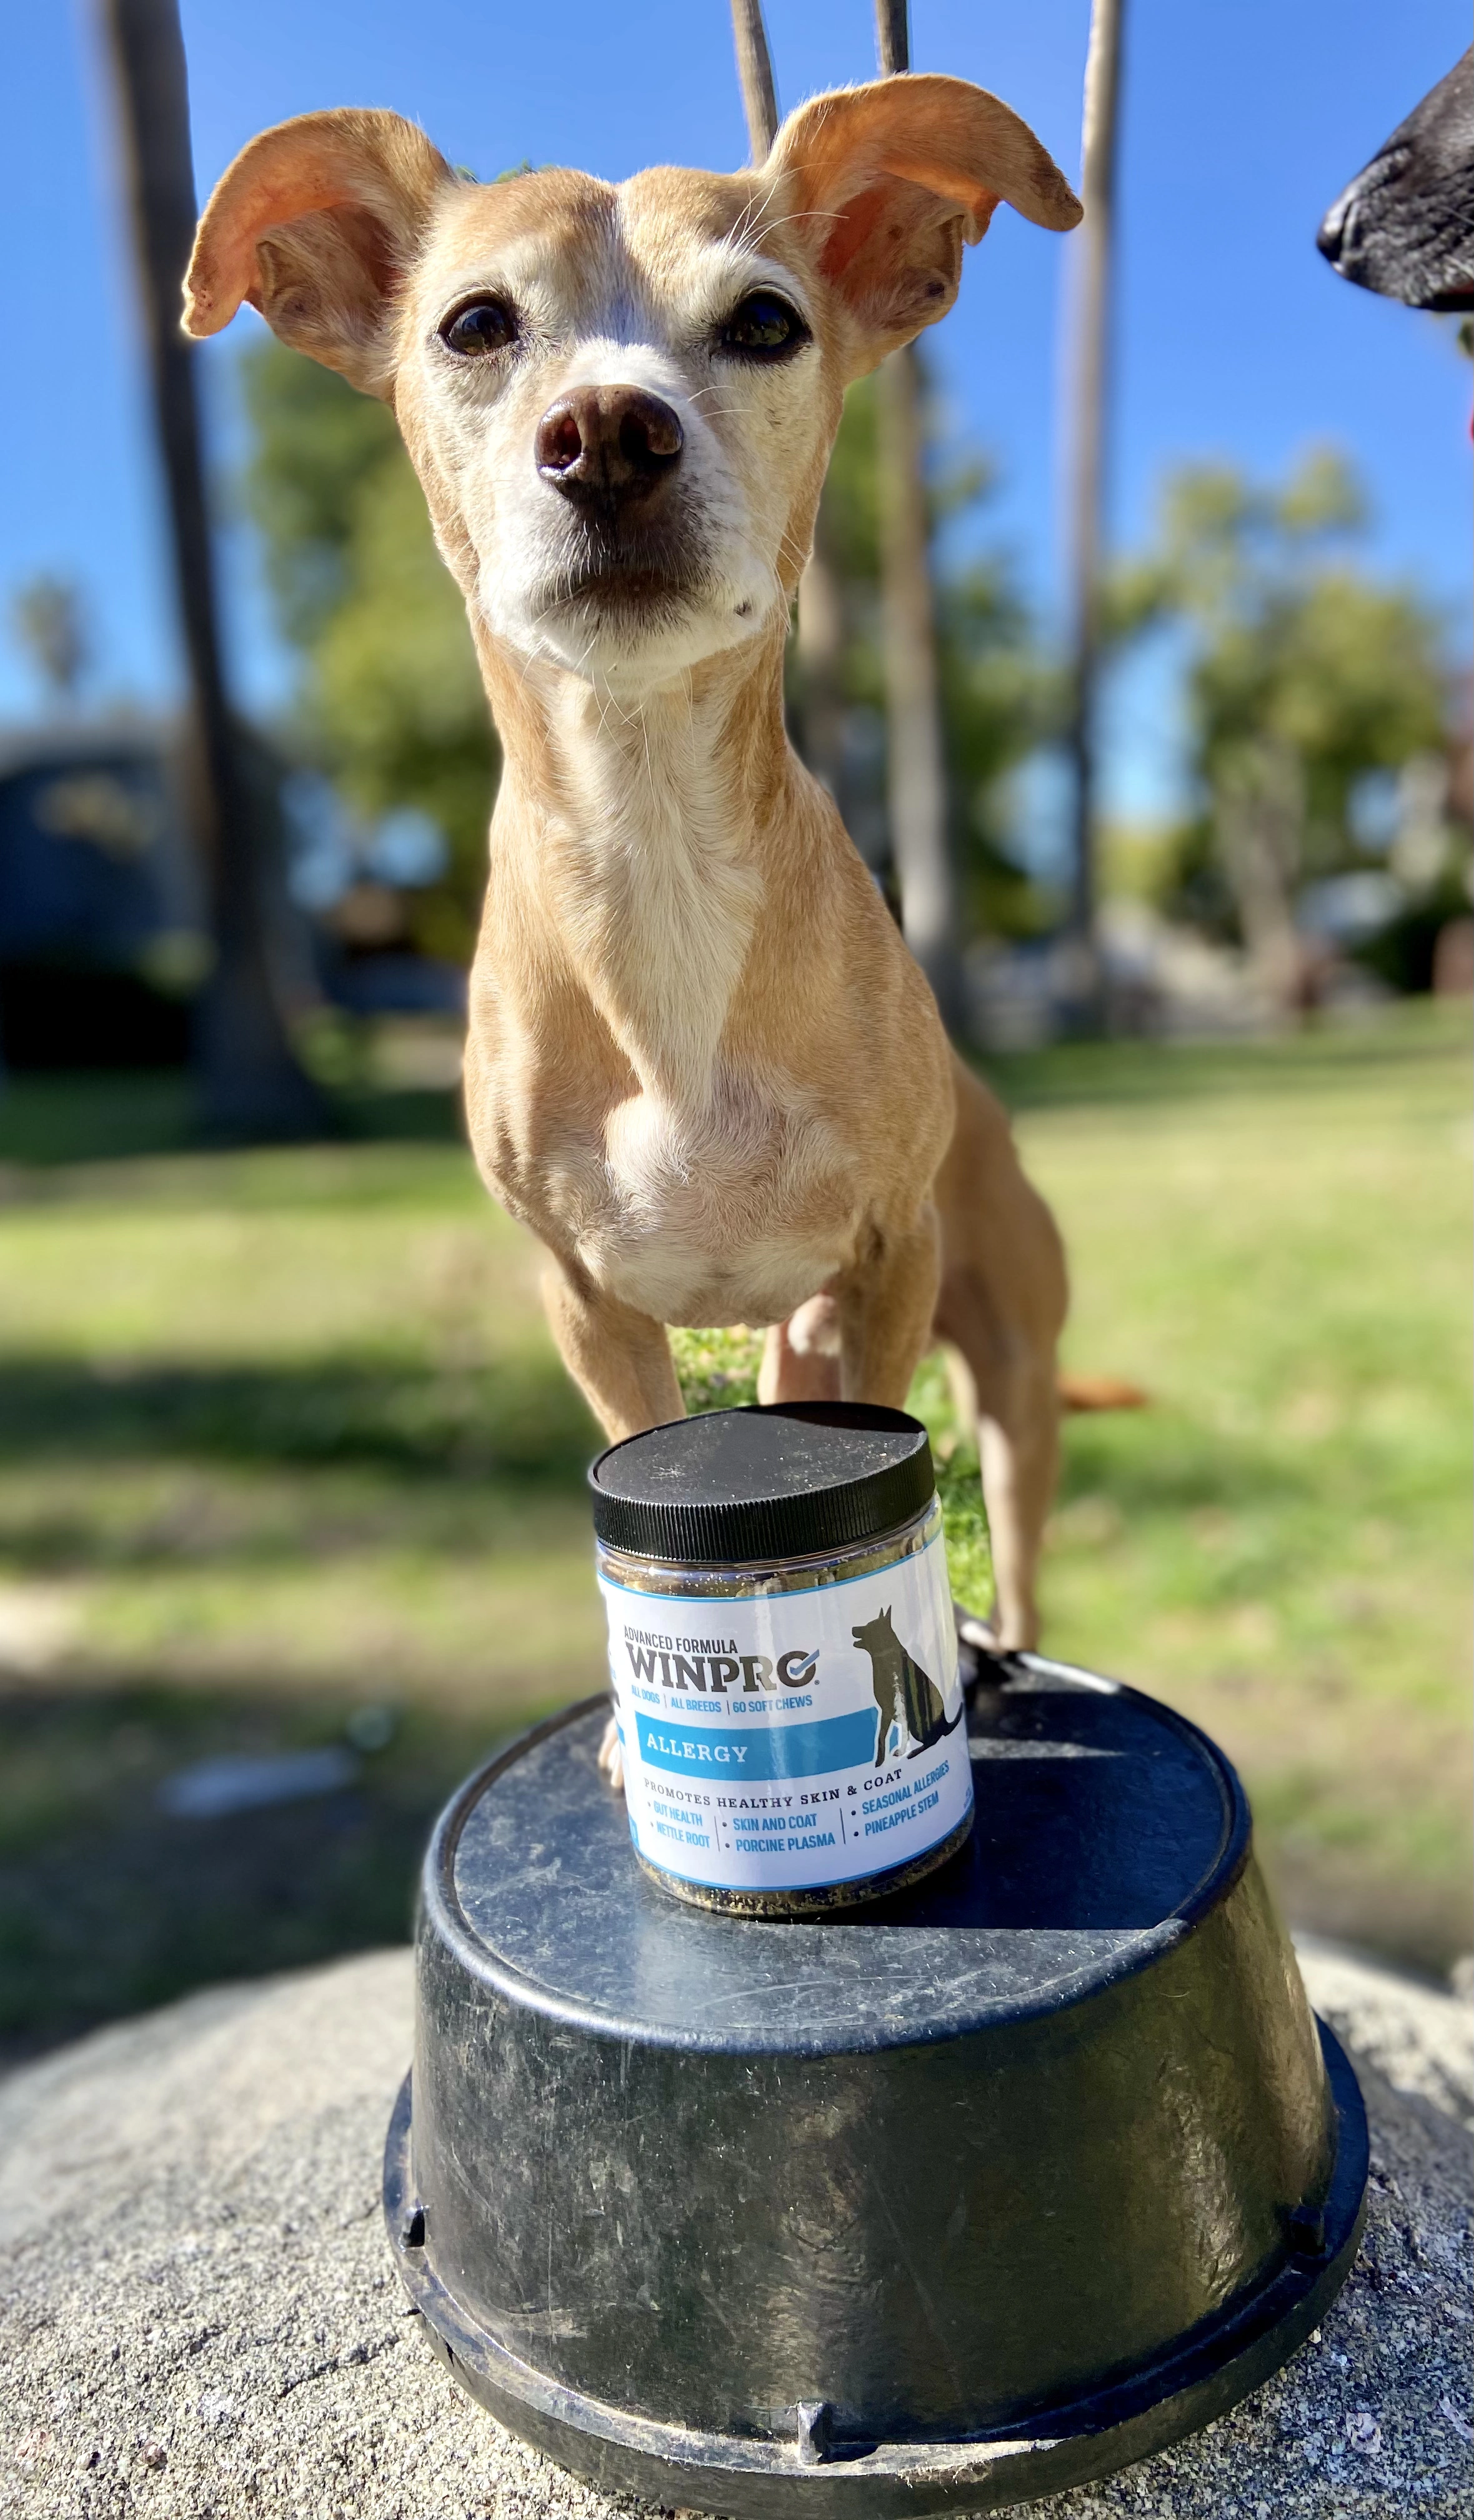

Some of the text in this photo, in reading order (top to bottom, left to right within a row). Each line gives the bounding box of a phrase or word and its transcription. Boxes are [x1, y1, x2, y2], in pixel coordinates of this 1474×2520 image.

[624, 1625, 739, 1654] ADVANCED FORMULA
[625, 1642, 820, 1692] WINPRO
[631, 1684, 660, 1704] ALL DOGS
[671, 1697, 722, 1712] ALL BREEDS
[733, 1694, 813, 1713] 60 SOFT CHEWS
[647, 1732, 748, 1762] ALLERGY
[644, 1769, 902, 1809] PROMOTES HEALTHY SKIN & COAT
[862, 1759, 950, 1815] SEASONAL ALLERGIES
[654, 1801, 703, 1826] GUT HEALTH
[733, 1813, 817, 1831] SKIN AND COAT
[864, 1804, 917, 1836] PINEAPPLE
[917, 1791, 939, 1813] STEM
[656, 1821, 710, 1848] NETTLE ROOT
[735, 1832, 836, 1852] PORCINE PLASMA
